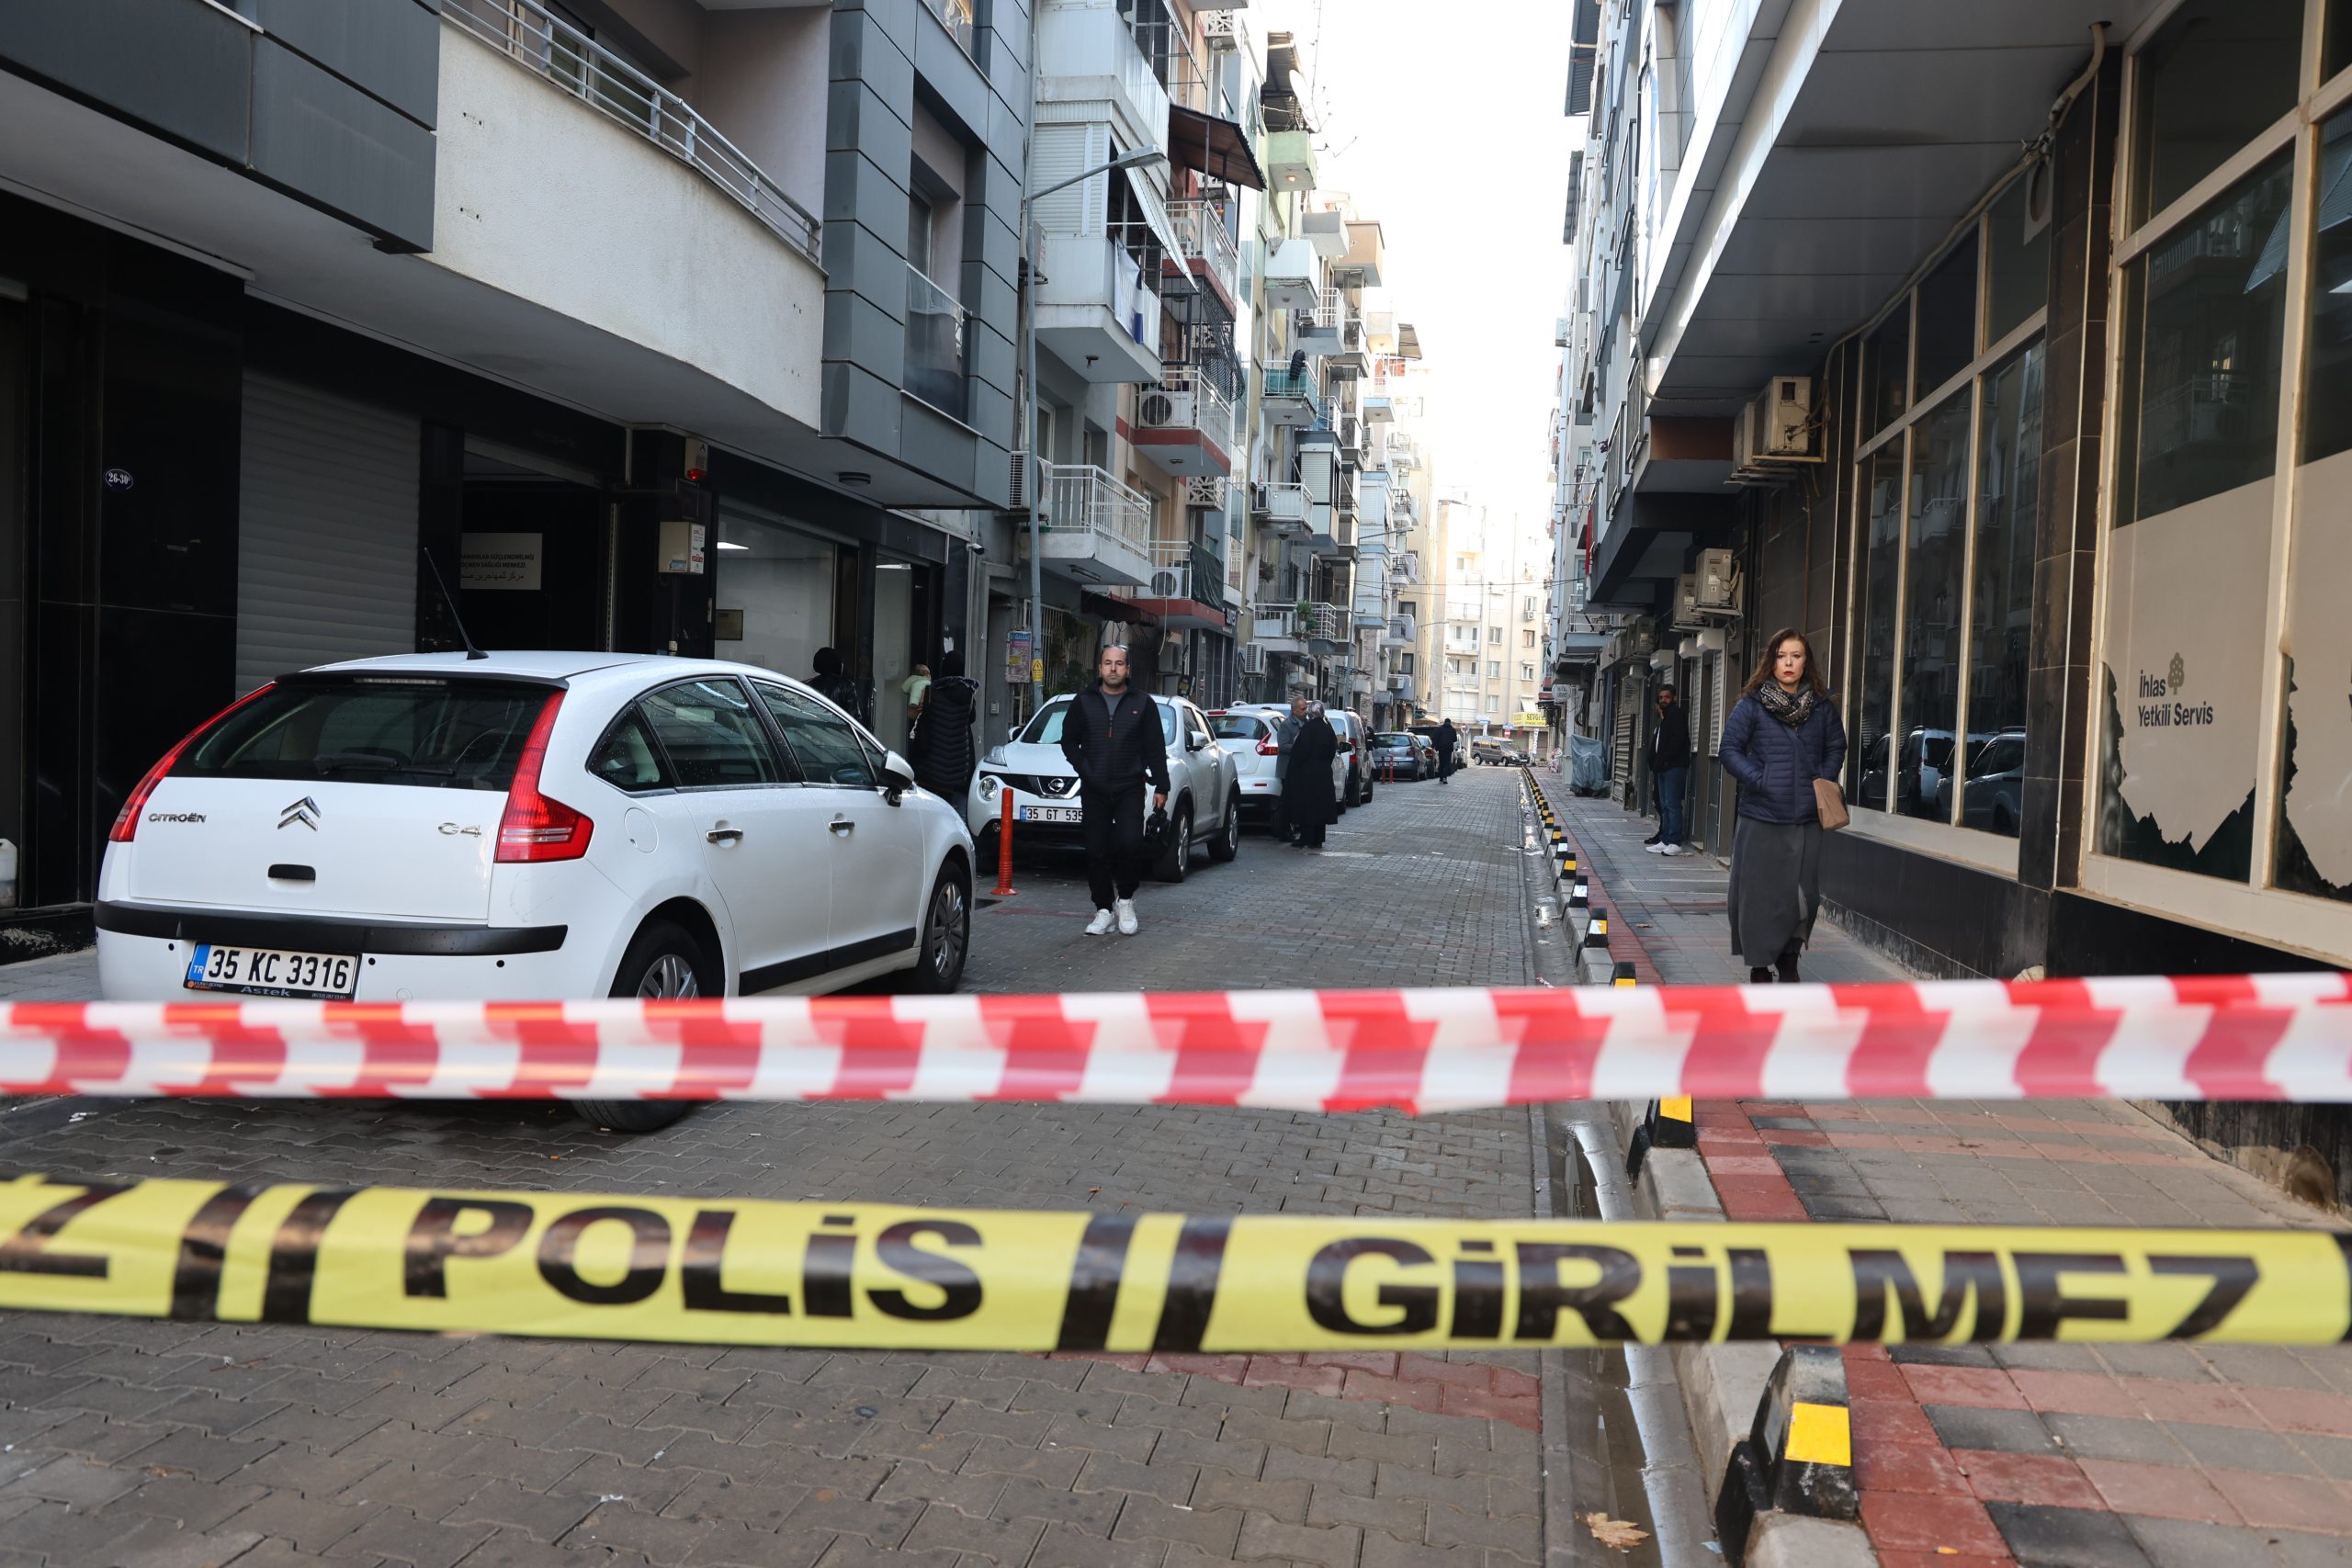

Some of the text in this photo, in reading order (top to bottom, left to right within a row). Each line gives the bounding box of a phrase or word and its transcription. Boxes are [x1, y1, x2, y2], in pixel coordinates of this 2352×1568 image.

[2139, 670, 2166, 698] İhlas
[2138, 701, 2213, 727] Yetkili Servis
[148, 813, 207, 823] CITROËN
[1026, 808, 1039, 819] 35
[1046, 809, 1058, 820] GT
[437, 822, 482, 838] C4
[193, 950, 350, 989] TR 35 KC 3316
[241, 986, 291, 998] Astek
